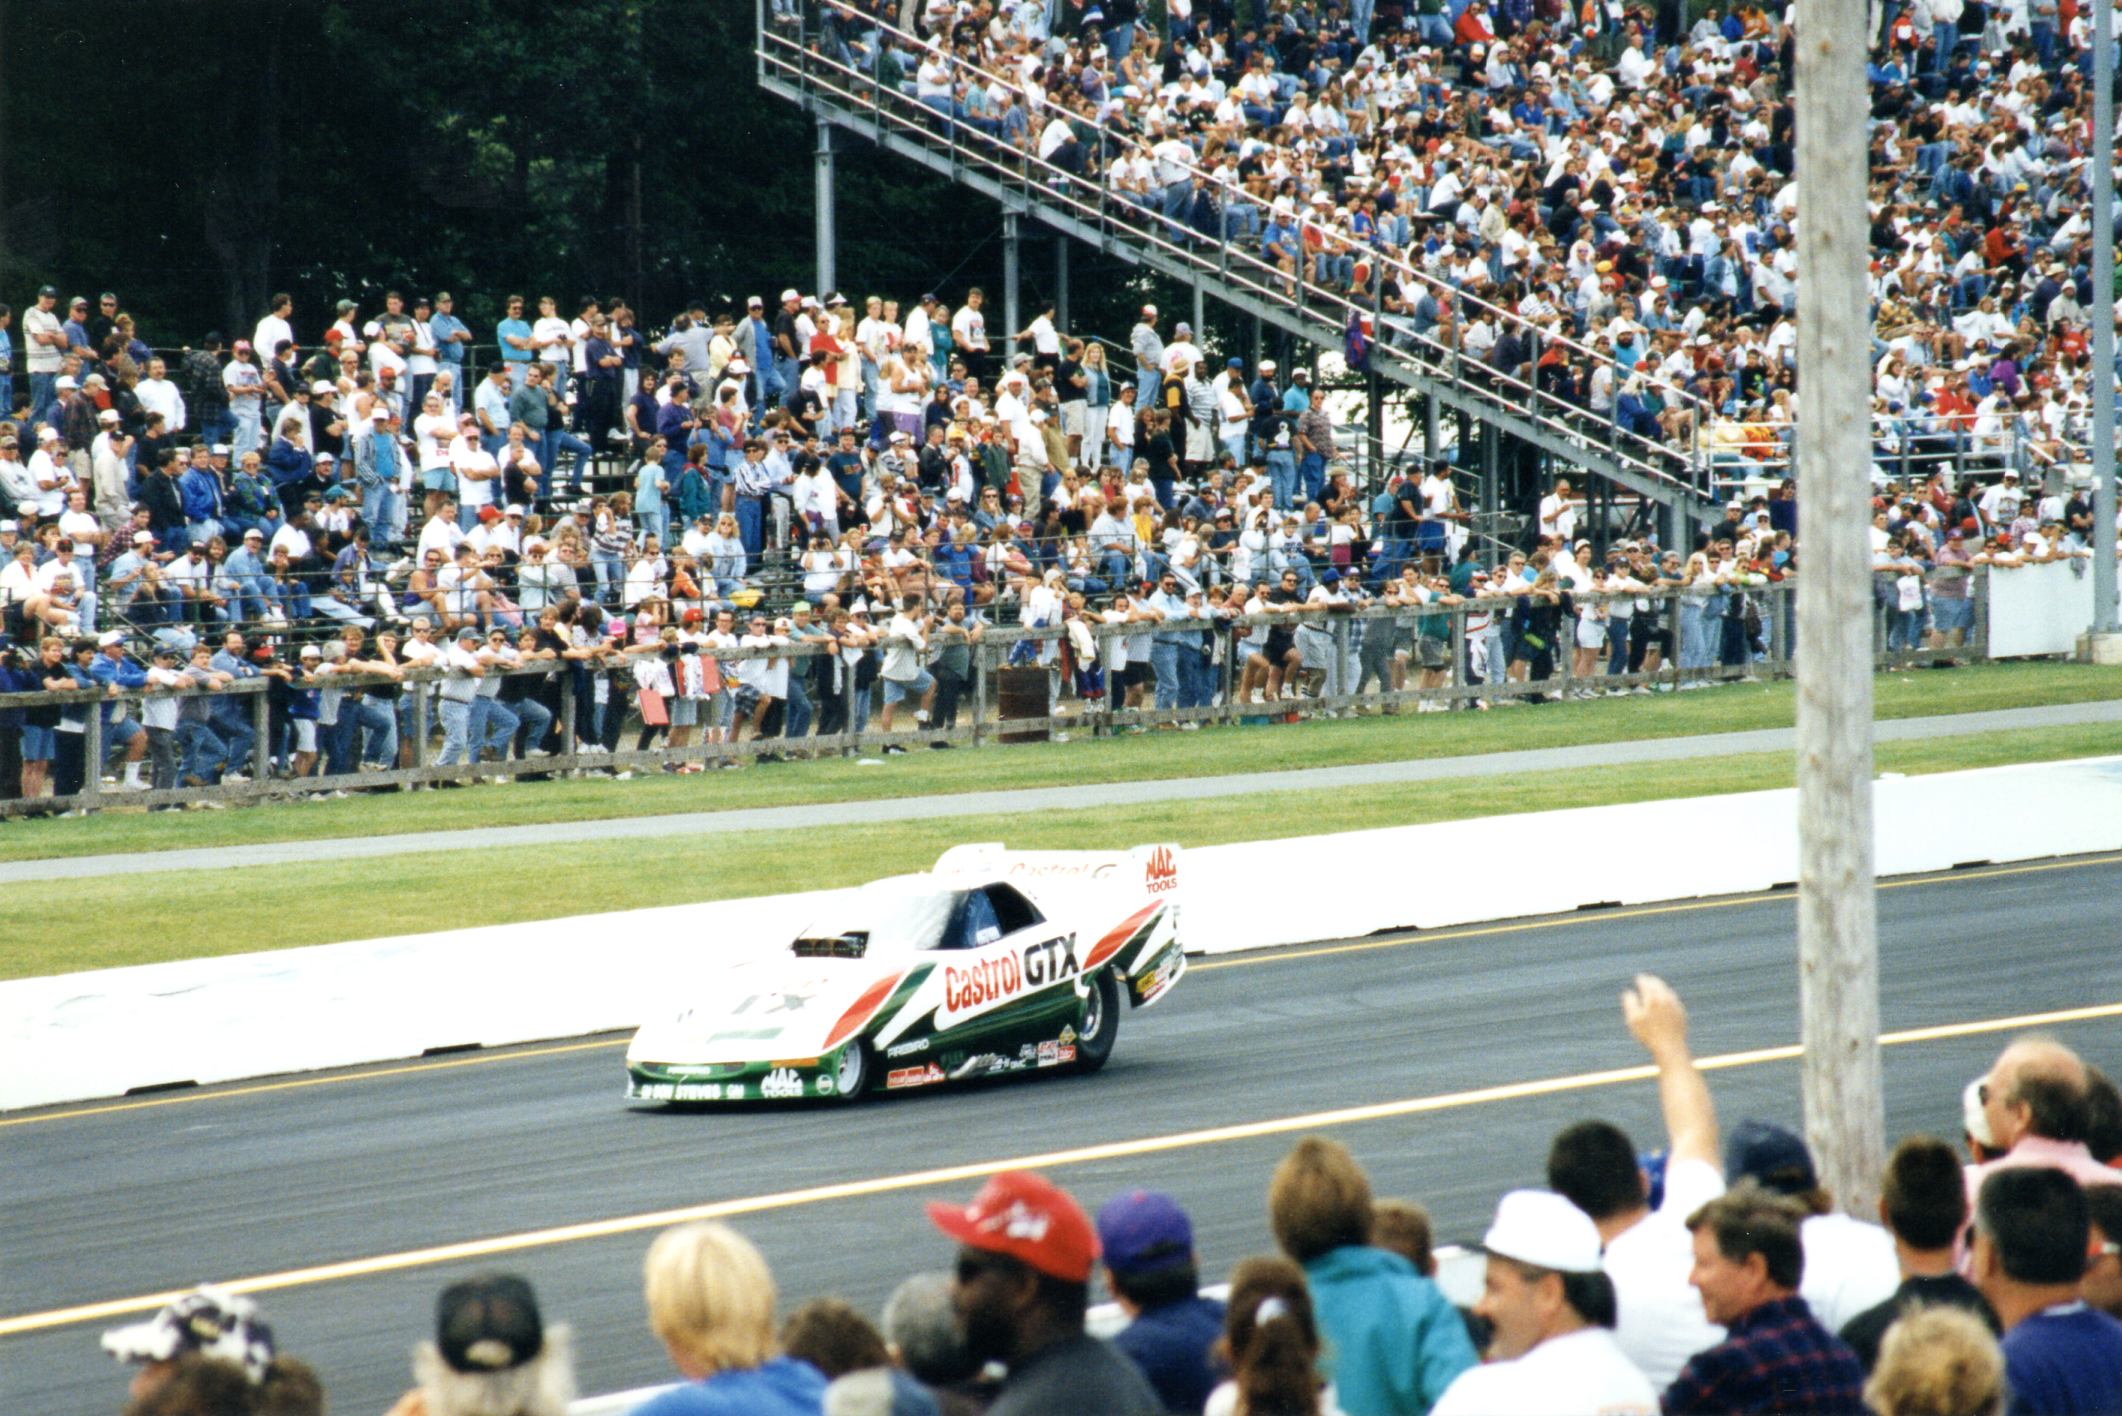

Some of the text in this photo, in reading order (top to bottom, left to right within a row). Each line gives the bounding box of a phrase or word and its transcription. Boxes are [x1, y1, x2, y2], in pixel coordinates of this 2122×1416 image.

[1145, 846, 1177, 881] MAC
[1146, 877, 1178, 895] TOOLS
[945, 931, 1080, 1013] Castrol GTX
